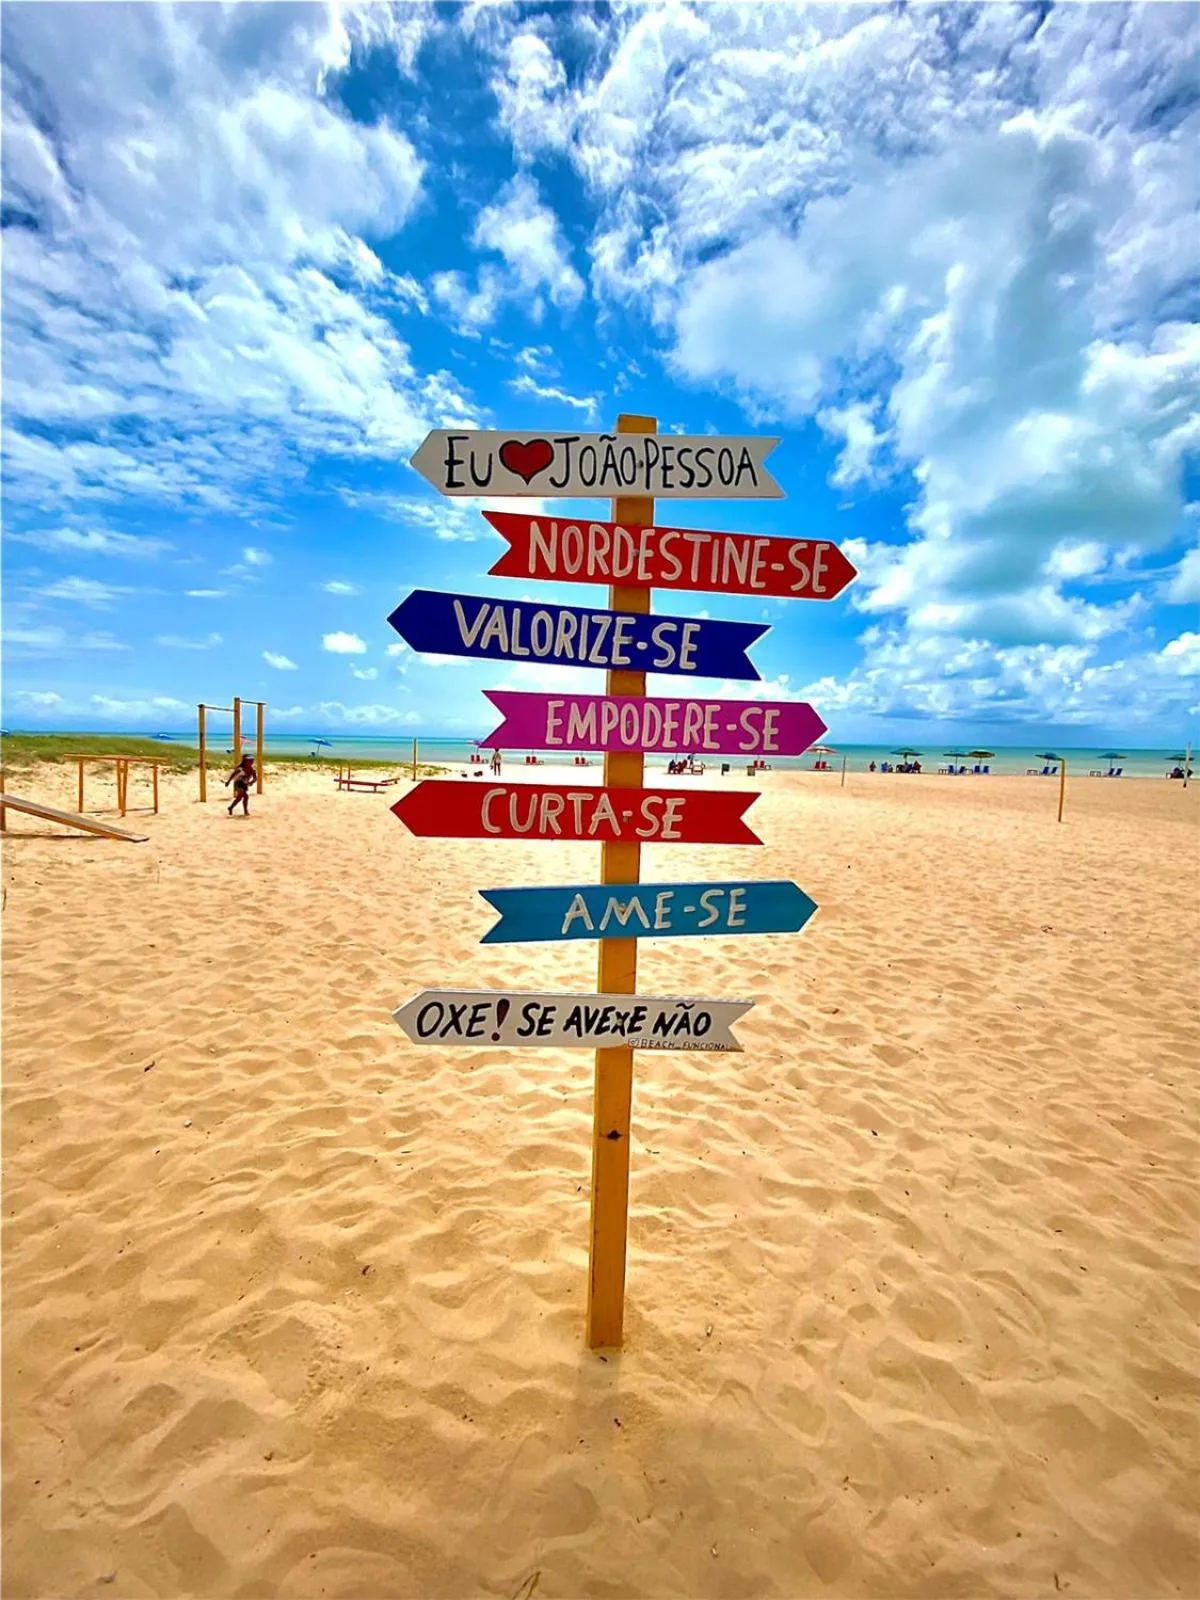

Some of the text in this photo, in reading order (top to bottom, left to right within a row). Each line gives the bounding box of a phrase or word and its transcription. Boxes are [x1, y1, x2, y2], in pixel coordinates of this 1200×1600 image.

[444, 434, 759, 489] EU JOÃO PESSOA
[529, 521, 831, 593] NORDESTINE-SE
[454, 600, 701, 670] VALORIZE-SE
[545, 700, 781, 752] EMPODERE-SE
[481, 788, 686, 839] CURTA-SE
[561, 888, 748, 934] AME-SE
[416, 999, 711, 1041] OXE! SE AVEXE NÃO
